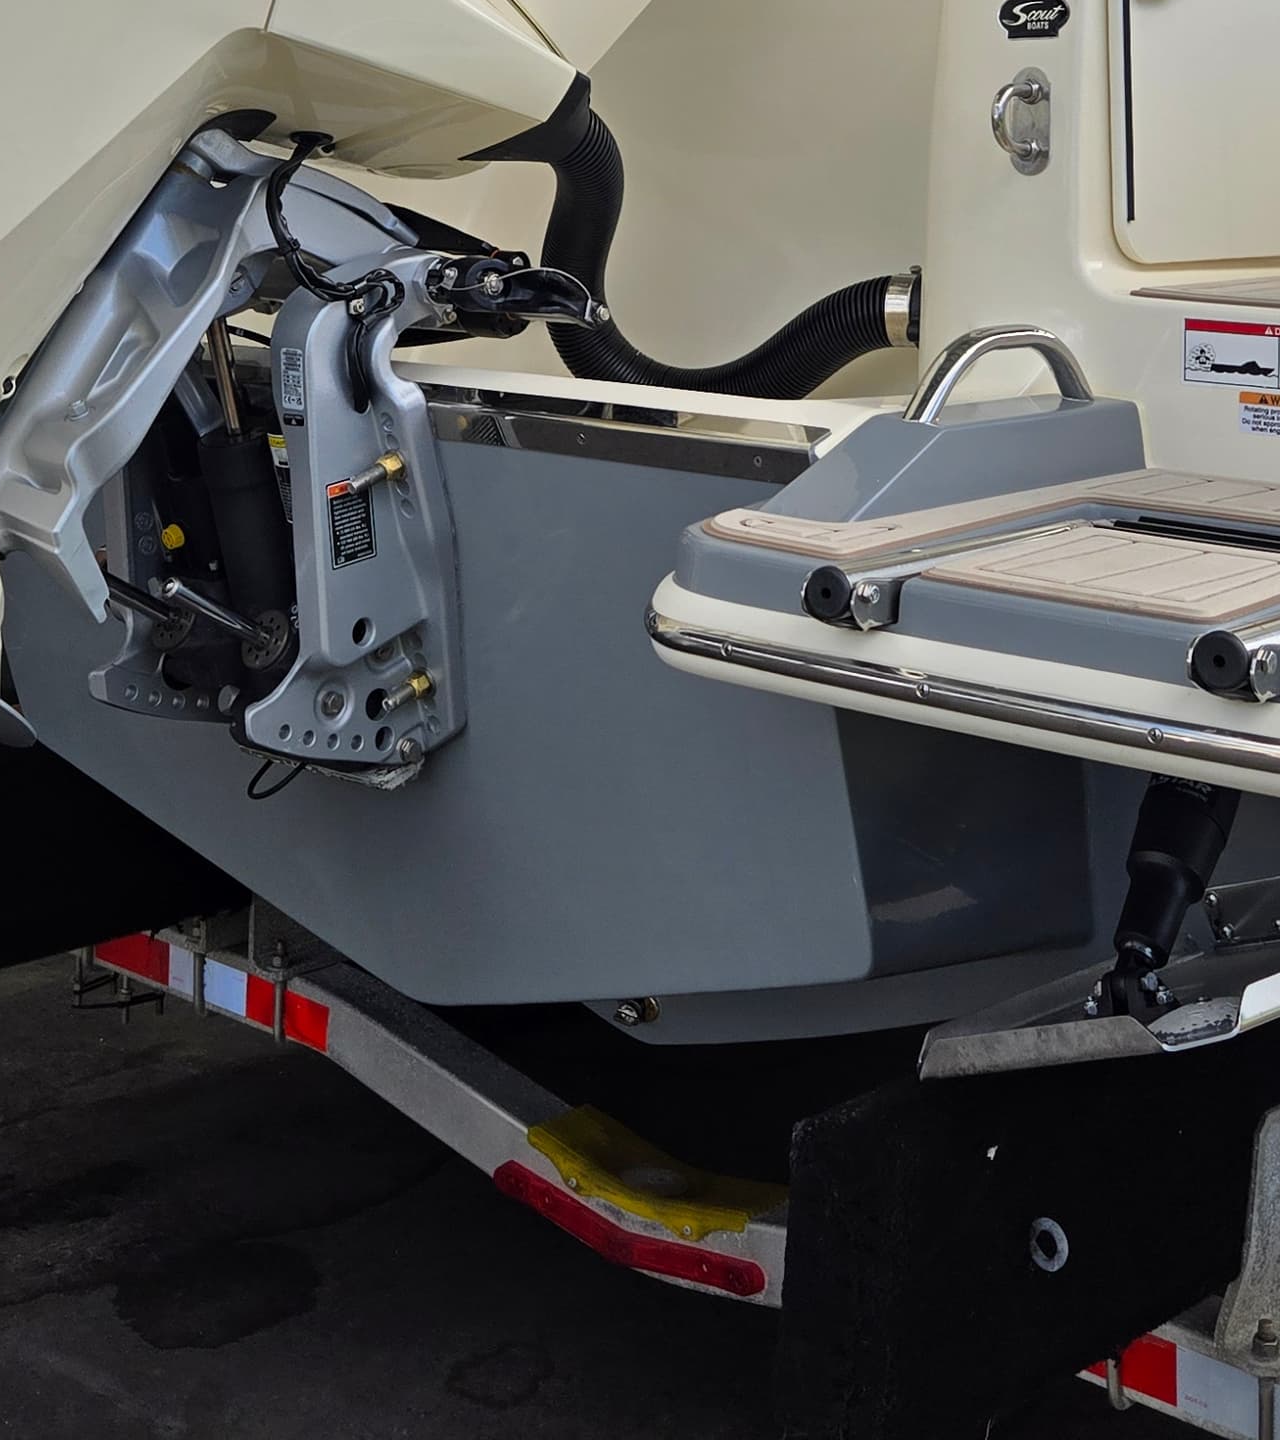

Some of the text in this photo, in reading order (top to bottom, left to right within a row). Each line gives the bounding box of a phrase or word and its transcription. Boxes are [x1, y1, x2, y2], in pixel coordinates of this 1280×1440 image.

[1002, 1, 1065, 27] Scout
[1027, 21, 1049, 30] BOATS
[1244, 405, 1269, 415] Rotating
